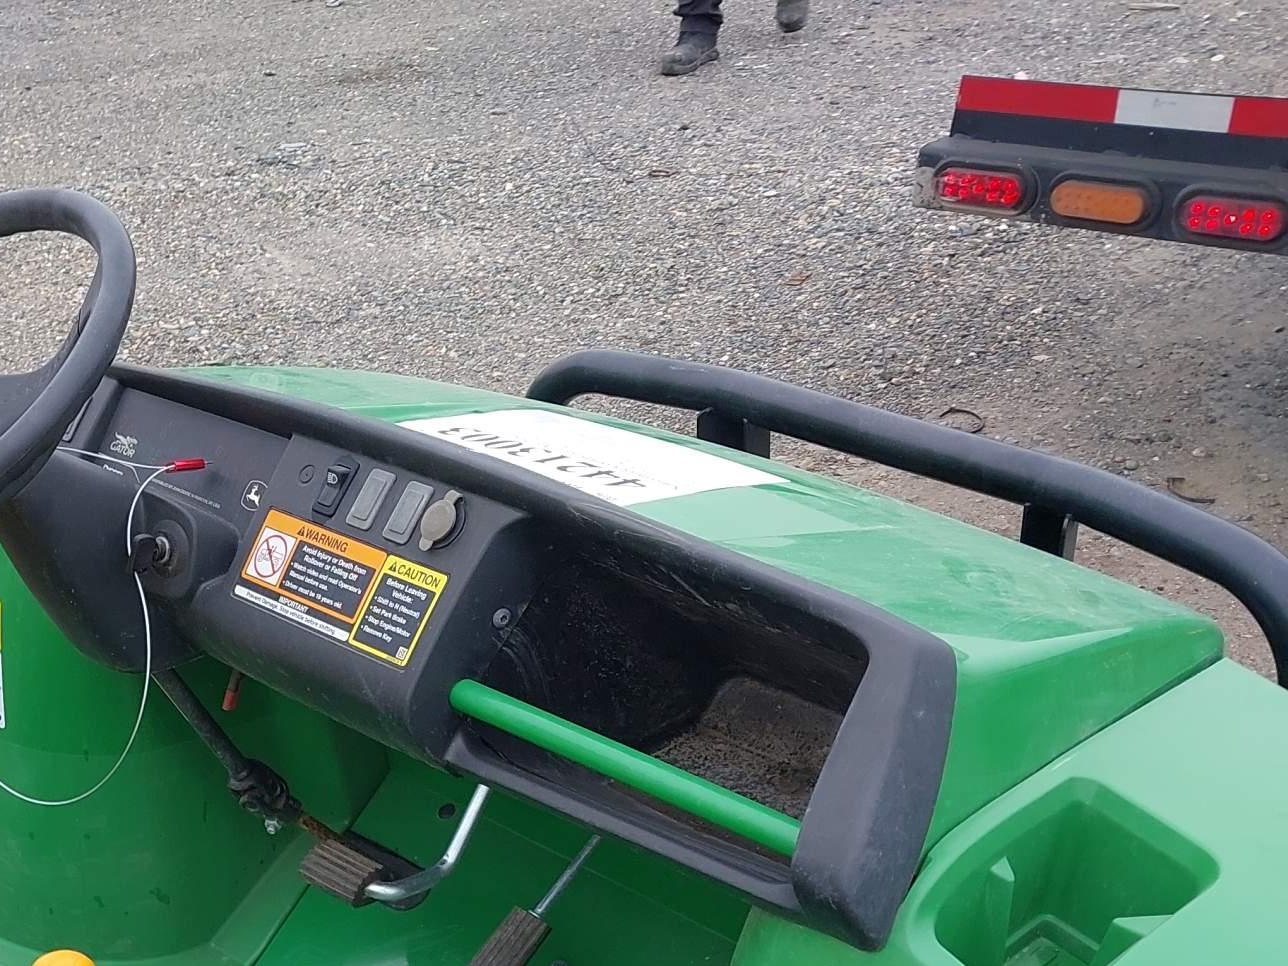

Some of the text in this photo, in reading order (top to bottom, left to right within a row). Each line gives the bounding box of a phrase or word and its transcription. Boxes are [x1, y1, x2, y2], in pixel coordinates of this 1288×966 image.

[110, 440, 136, 458] GATOR
[303, 528, 349, 553] WARNING
[302, 545, 317, 556] Avoid
[396, 563, 441, 588] CAUTION
[385, 577, 428, 601] Before Leaving
[390, 589, 414, 603] Vehicle:
[277, 595, 309, 613] IMPORTANT
